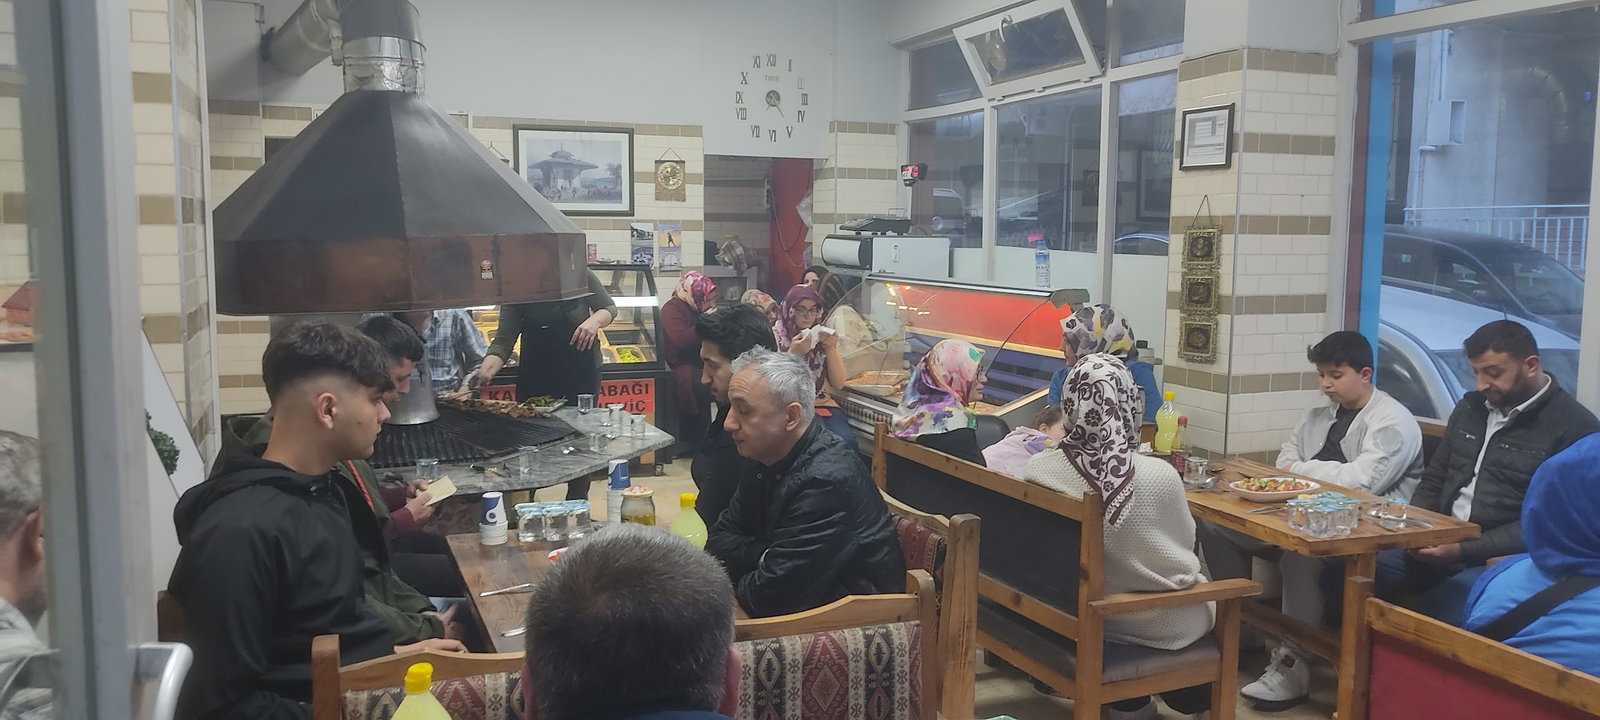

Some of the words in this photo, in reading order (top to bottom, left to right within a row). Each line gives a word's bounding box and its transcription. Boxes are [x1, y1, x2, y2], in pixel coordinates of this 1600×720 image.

[753, 55, 761, 68] XI
[766, 53, 777, 67] XII
[788, 59, 793, 72] I
[740, 72, 748, 85] X
[736, 91, 744, 104] IX
[736, 107, 747, 121] VIII
[797, 110, 805, 123] IV
[751, 124, 760, 138] VII
[768, 129, 777, 142] VI
[786, 125, 793, 139] V
[489, 390, 513, 402] KA
[600, 381, 649, 397] ABAĞI
